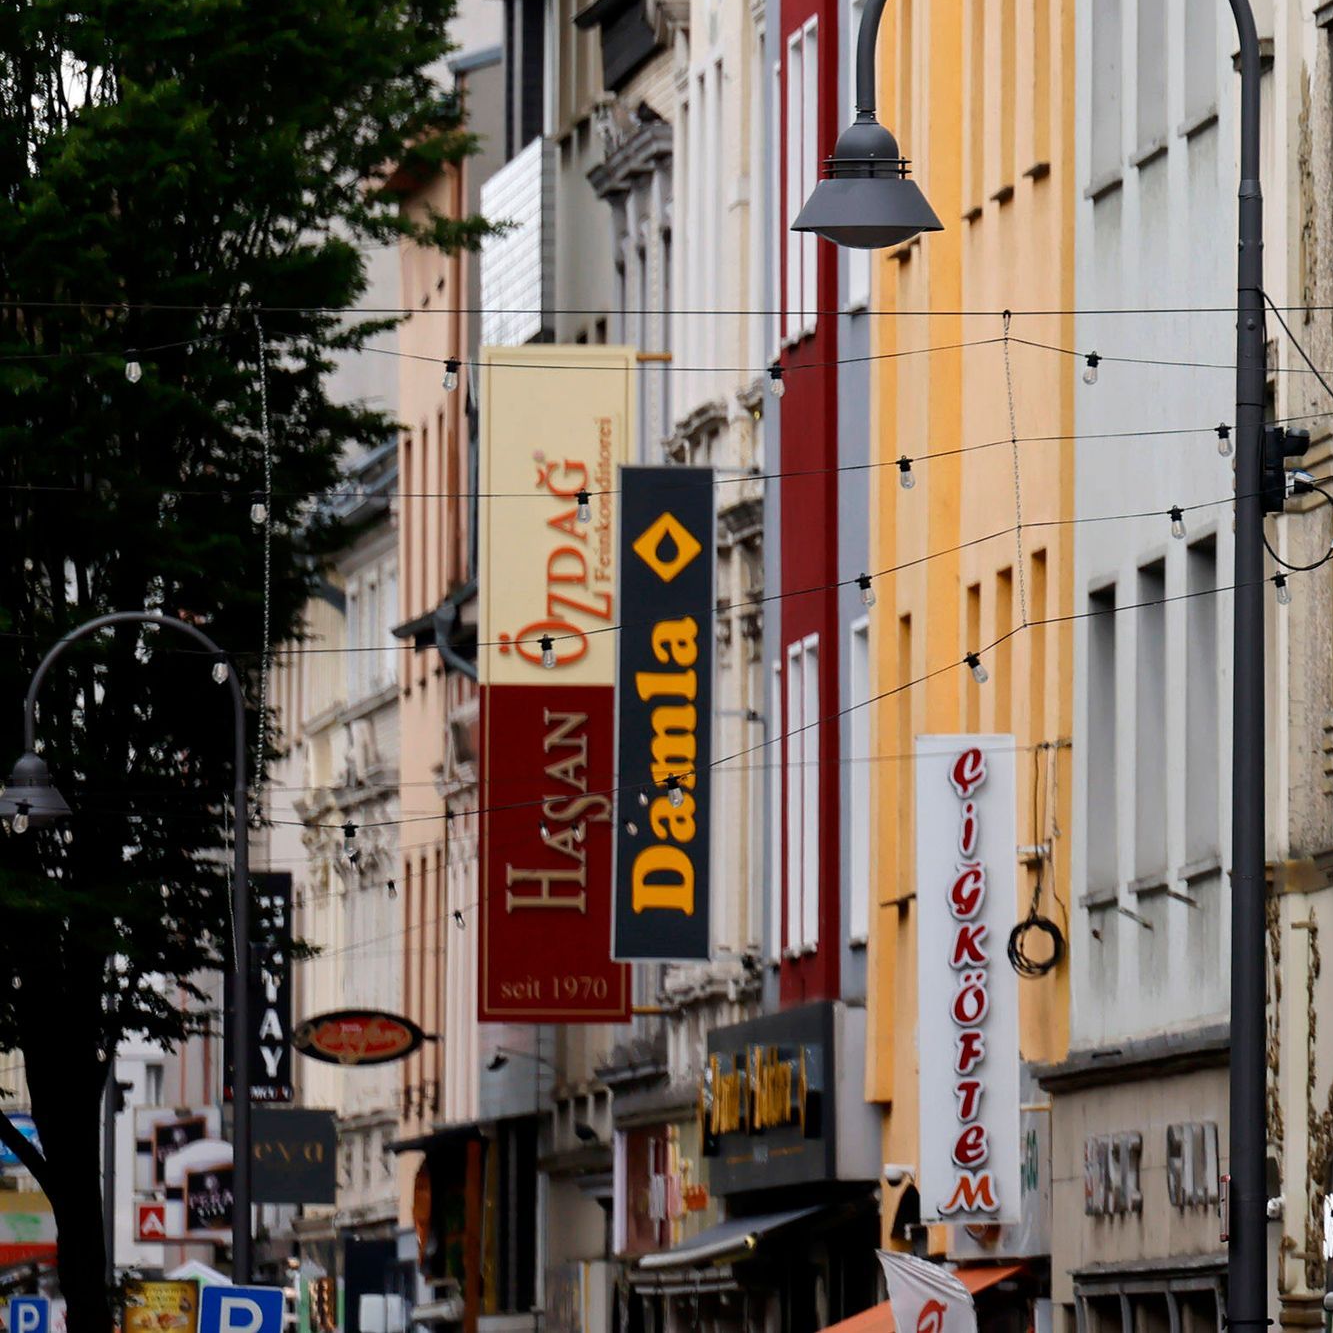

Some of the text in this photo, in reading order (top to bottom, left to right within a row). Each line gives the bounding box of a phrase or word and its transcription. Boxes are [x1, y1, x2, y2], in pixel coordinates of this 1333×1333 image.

[631, 616, 698, 916] Damla
[551, 976, 609, 1001] 1970
[18, 1303, 40, 1333] P
[219, 1296, 264, 1333] P
